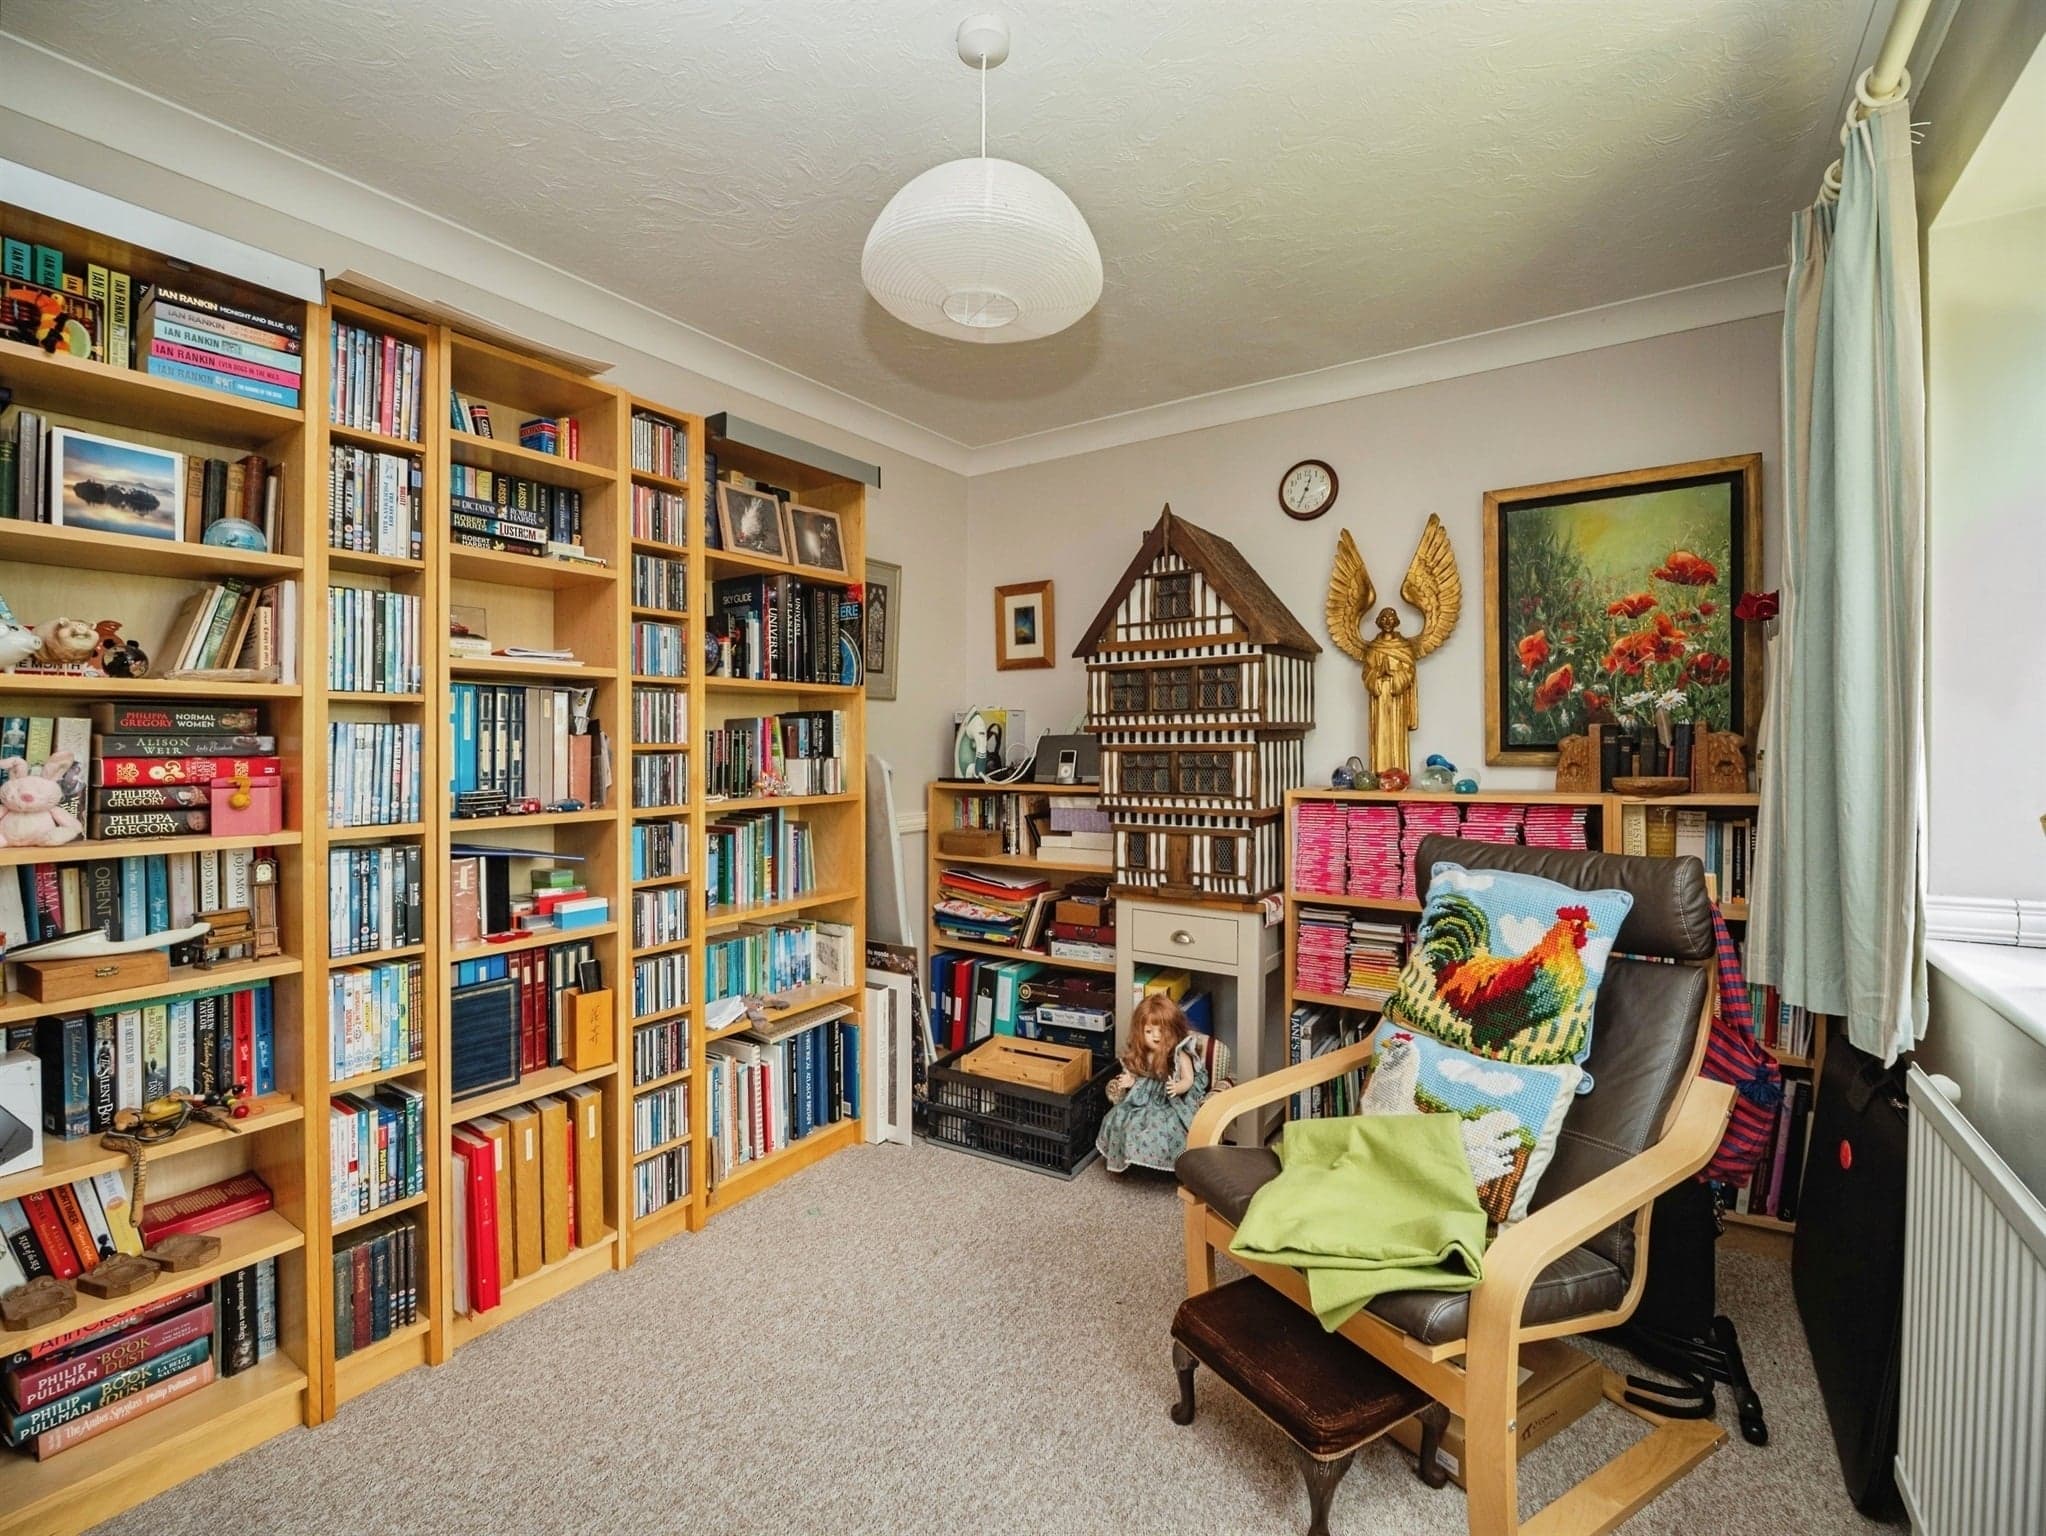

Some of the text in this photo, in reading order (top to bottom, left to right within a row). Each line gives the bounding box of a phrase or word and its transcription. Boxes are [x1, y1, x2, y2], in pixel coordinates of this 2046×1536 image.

[92, 271, 105, 290] IAN
[115, 280, 126, 296] IAN
[114, 296, 126, 326] RANKIN
[158, 288, 178, 301] IAN
[179, 294, 218, 311] RANKIN
[220, 305, 252, 320] MIDNIGHT
[252, 313, 267, 324] AND
[267, 318, 285, 329] BLUE
[168, 309, 225, 331] IAN RANKIN
[164, 327, 220, 348] IAN RANKIN
[156, 345, 174, 357] IAN
[178, 349, 216, 365] RANKIN
[157, 365, 214, 385] IAN RANKIN
[497, 479, 506, 504] LARSSO
[462, 501, 495, 514] DICTATOR
[454, 514, 487, 524] ROBERT
[454, 519, 487, 531] HARRIS
[462, 535, 490, 544] ROBERT
[462, 540, 490, 550] HARRIS
[734, 593, 752, 604] GUIDE
[769, 608, 778, 659] UNIVERSE
[120, 719, 173, 727] GREGORY
[126, 712, 168, 720] PHILIPPA
[176, 713, 216, 721] NORMAL
[136, 737, 190, 747] ALISON
[144, 746, 183, 755] WEIR
[108, 796, 167, 808] GREGORY
[111, 789, 162, 799] PHILIPPA
[105, 822, 179, 836] GREGORY
[111, 814, 174, 826] PHILIPPA
[203, 853, 214, 912] JOJO MOYES
[233, 852, 245, 904] JOJO MOYE
[43, 871, 60, 914] EMMA
[95, 867, 113, 916] ORIENT
[46, 924, 57, 938] Fro
[1291, 1018, 1301, 1050] JANE'S
[96, 1068, 114, 1103] SILENT
[97, 1103, 114, 1125] BOY
[39, 1328, 81, 1352] Ann
[101, 1336, 151, 1364] BOOK
[105, 1350, 146, 1375] DUST
[157, 1361, 192, 1379] SAUVAGE
[169, 1354, 192, 1369] BELLE
[27, 1368, 98, 1405] PULLMAN
[38, 1362, 87, 1390] PHILIP
[101, 1367, 153, 1397] BOOK
[105, 1381, 149, 1406] DUST
[31, 1396, 81, 1424] PHILIP
[65, 1375, 197, 1440] The Amber Spyglass Philip Pullman
[20, 1402, 92, 1441] PULLMAN
